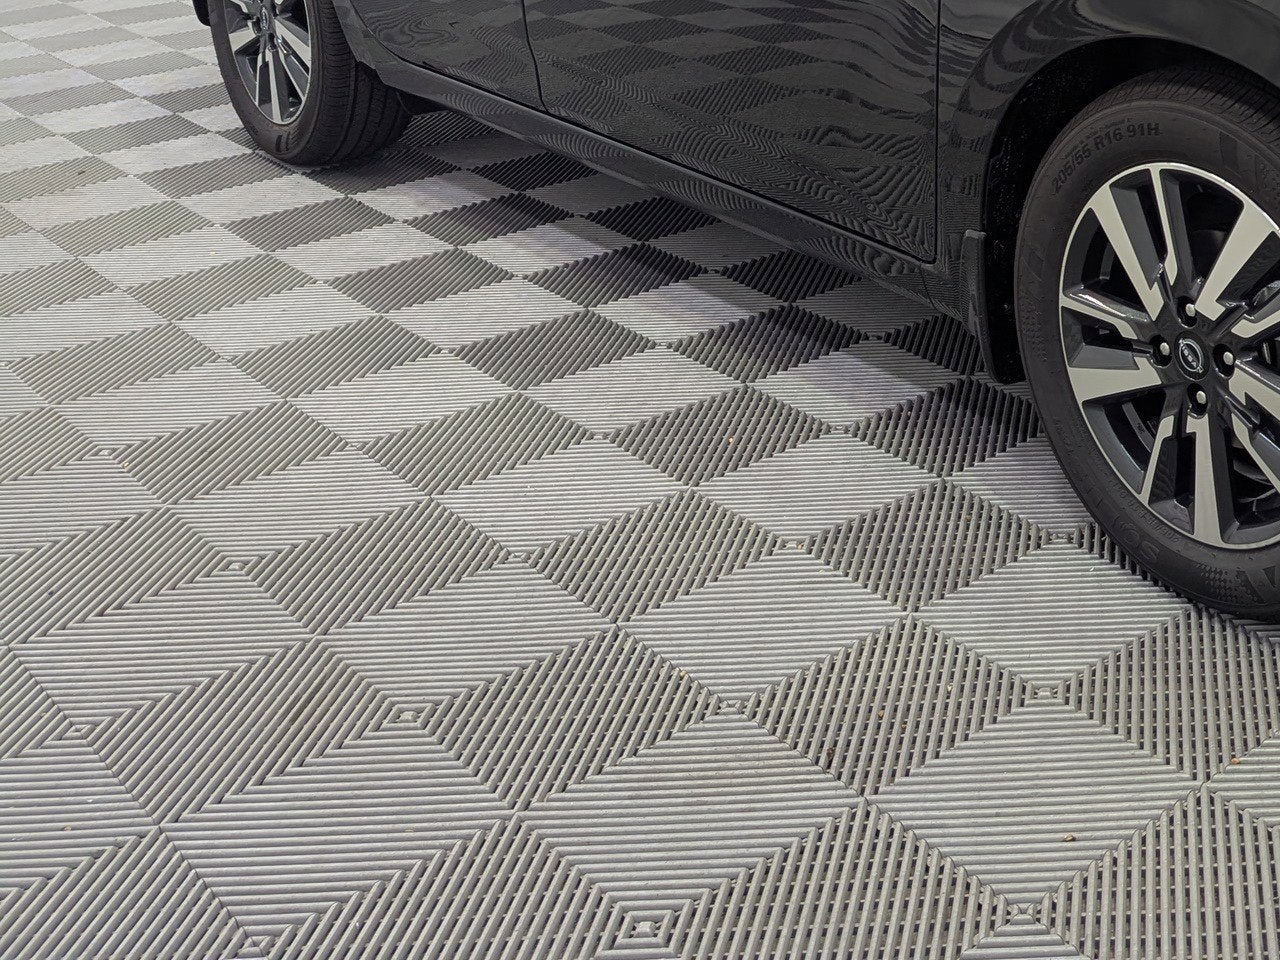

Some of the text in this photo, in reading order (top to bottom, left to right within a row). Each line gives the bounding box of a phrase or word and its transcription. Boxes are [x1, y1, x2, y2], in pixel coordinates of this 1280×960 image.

[1050, 122, 1162, 196] 205/55 R16 91H
